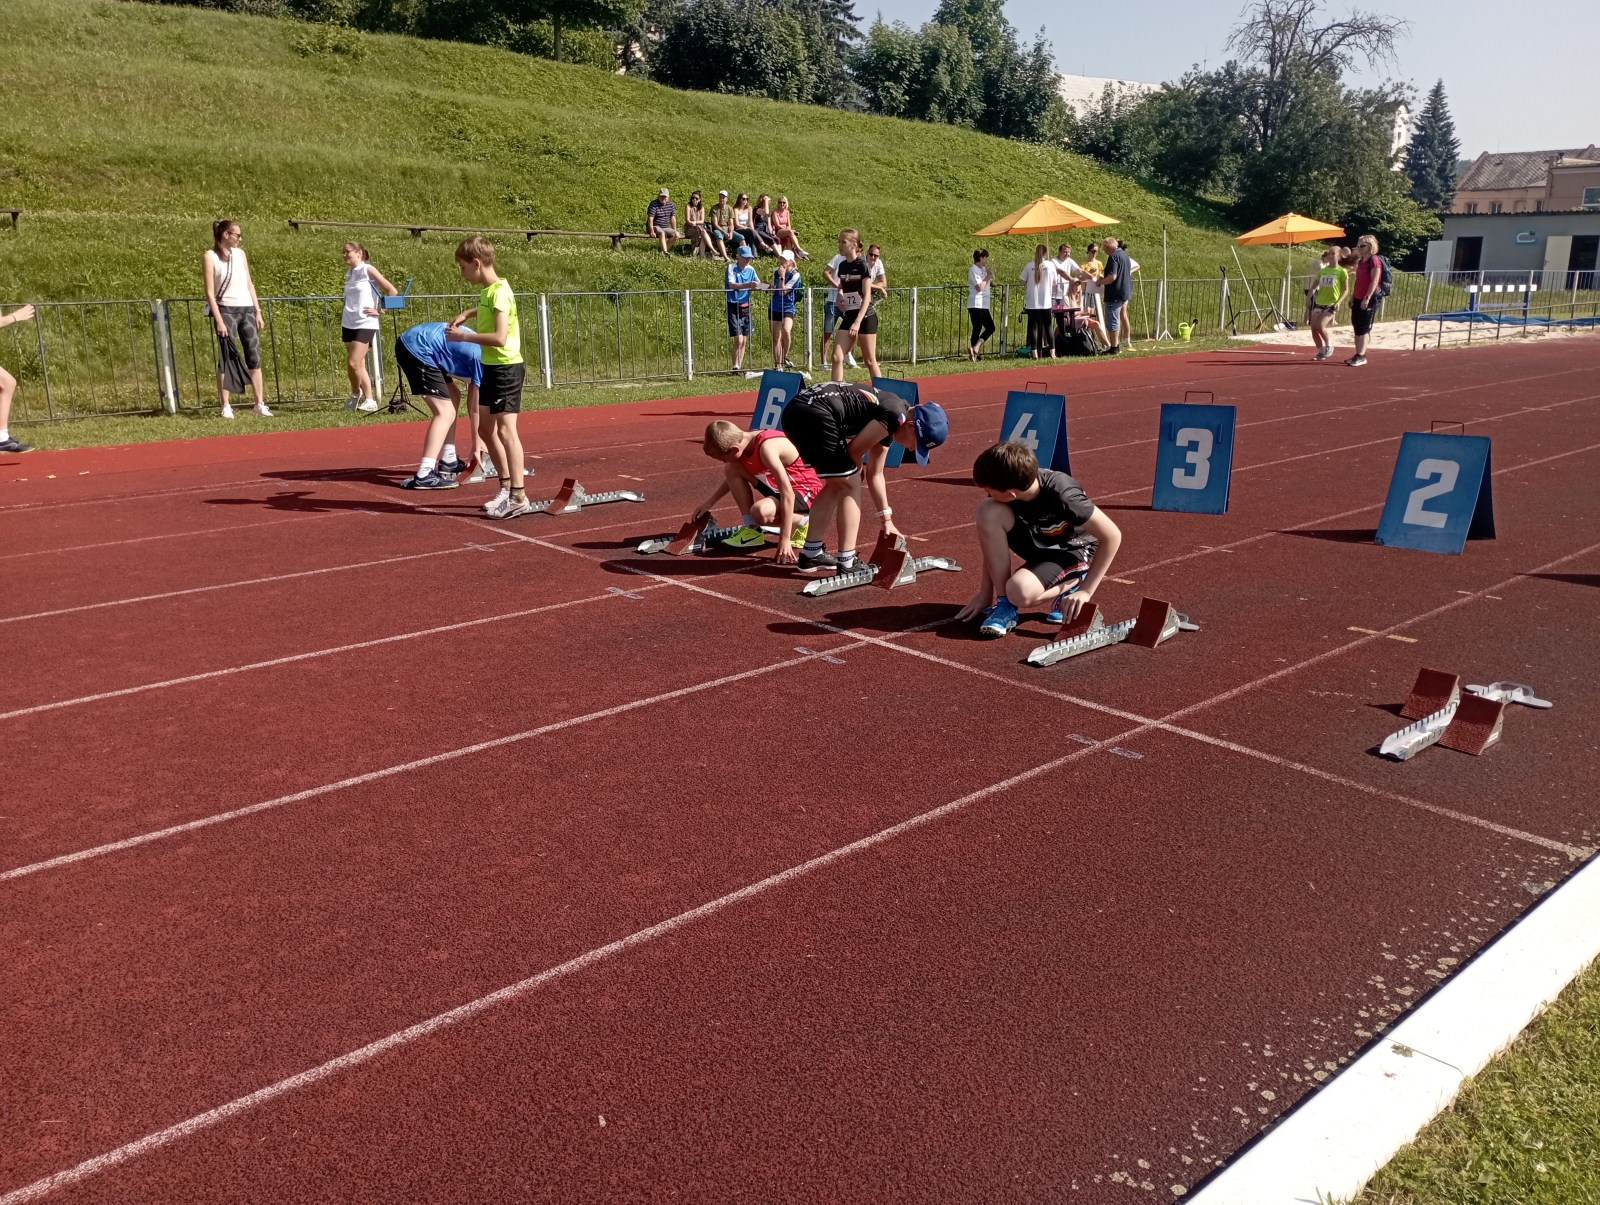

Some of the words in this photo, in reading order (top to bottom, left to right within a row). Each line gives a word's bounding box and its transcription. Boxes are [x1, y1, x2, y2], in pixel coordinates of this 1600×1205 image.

[847, 296, 857, 305] 72
[760, 387, 787, 430] 6
[1008, 412, 1040, 450] 4
[1171, 427, 1214, 490] 3
[1402, 458, 1460, 529] 2
